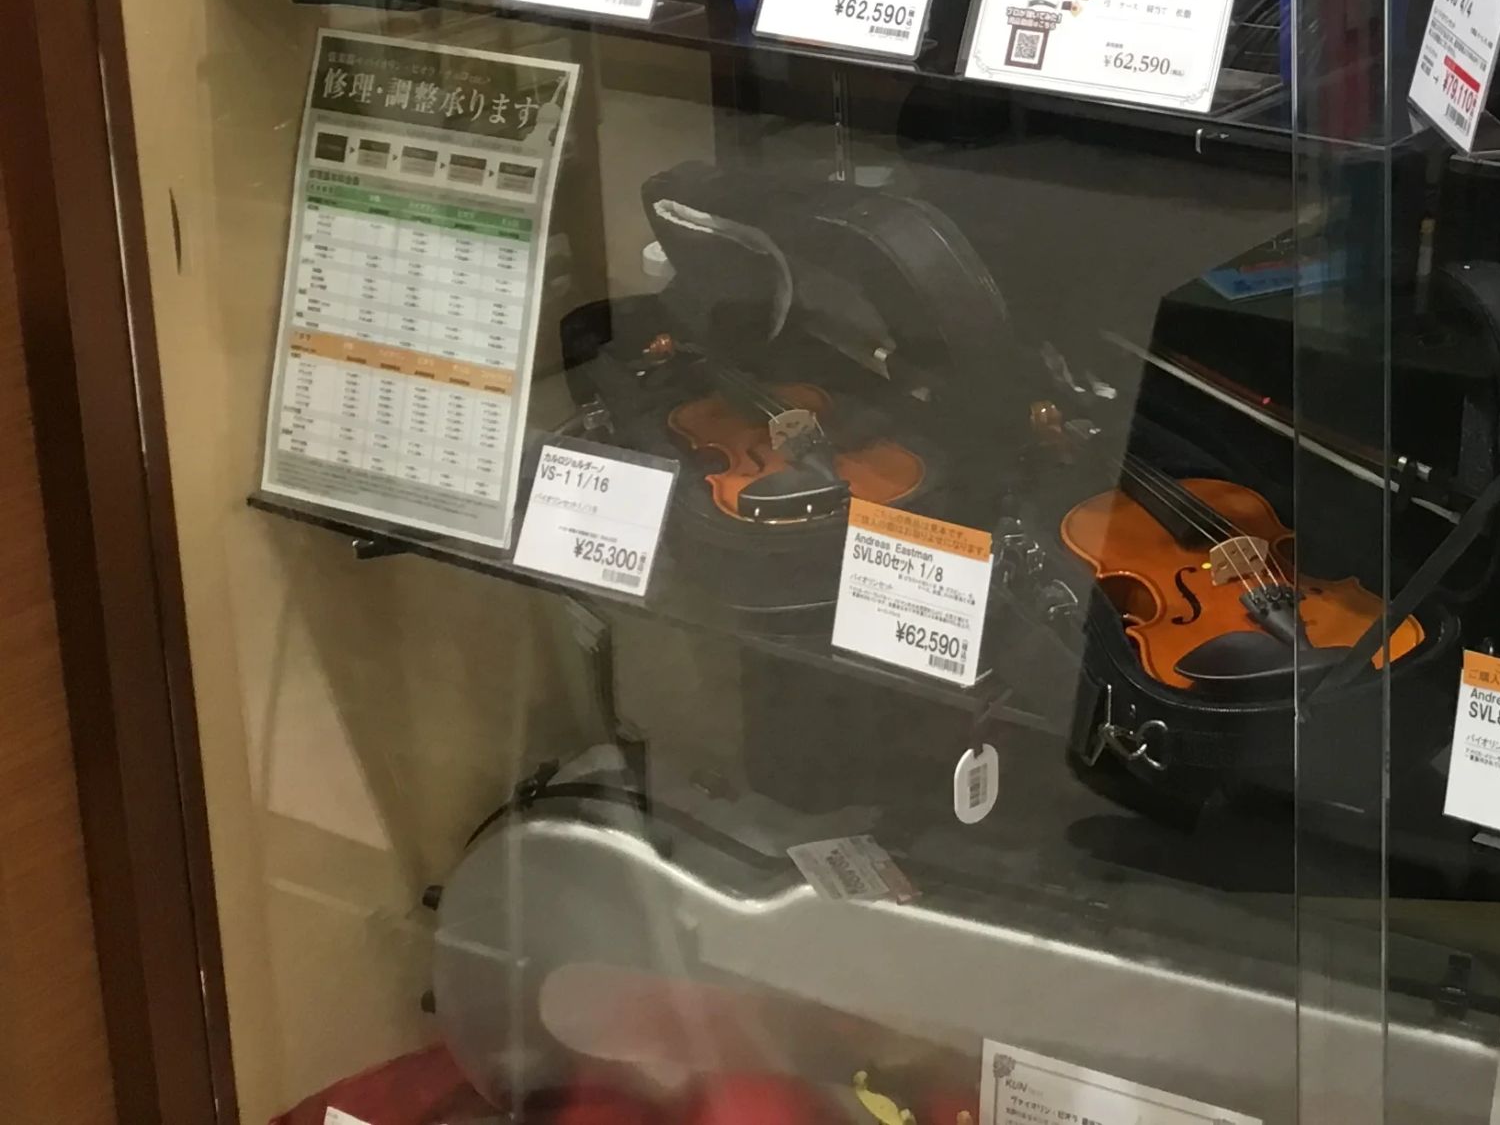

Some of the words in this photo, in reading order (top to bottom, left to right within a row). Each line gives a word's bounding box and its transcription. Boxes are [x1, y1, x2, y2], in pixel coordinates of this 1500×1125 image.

[1103, 51, 1170, 76] ¥62,590
[323, 67, 540, 129] 修理・調整承ります
[540, 464, 572, 486] VS-1
[576, 472, 610, 493] 1/16
[573, 537, 637, 571] ¥25,300
[852, 544, 915, 575] SVL80セット
[920, 562, 944, 583] 1/8
[854, 532, 891, 551] Andreas
[895, 543, 934, 563] Eastman
[895, 620, 960, 659] ¥62,590
